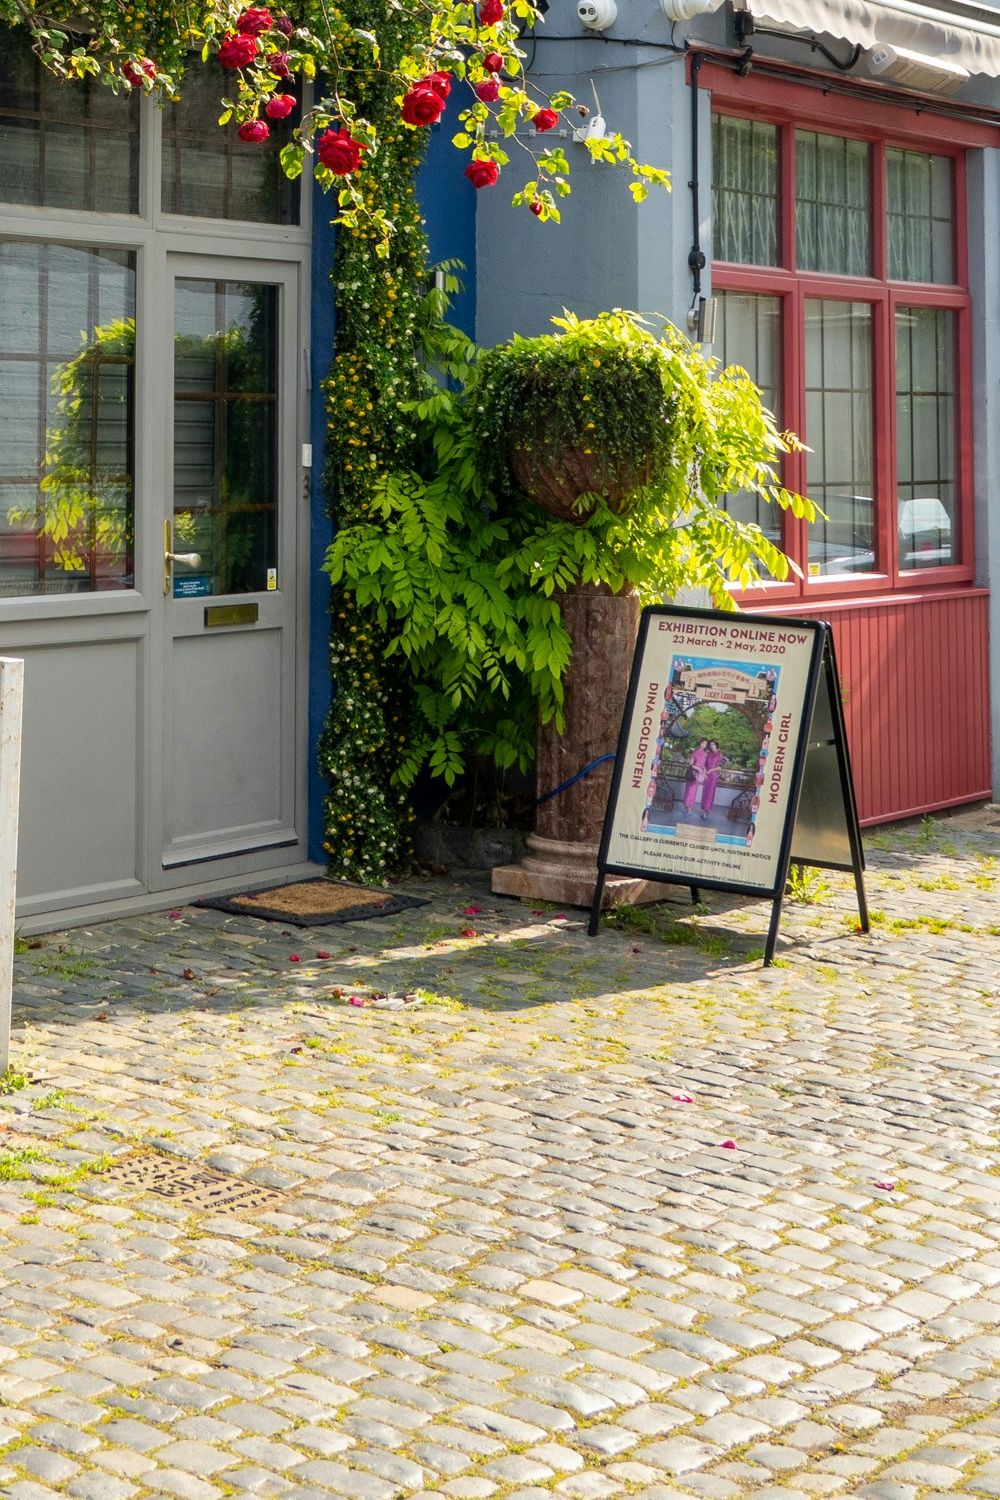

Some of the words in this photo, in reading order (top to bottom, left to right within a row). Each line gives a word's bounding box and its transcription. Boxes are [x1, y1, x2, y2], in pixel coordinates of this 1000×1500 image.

[658, 621, 727, 637] EXHIBITION
[730, 628, 775, 642] ONLINE
[778, 633, 807, 644] NOW
[672, 635, 684, 644] 23
[686, 636, 717, 647] March
[726, 640, 732, 649] 2
[734, 642, 757, 652] May,
[760, 644, 785, 654] 2020
[644, 682, 659, 713] DINA
[631, 716, 652, 789] GOLDSTEIN
[768, 746, 786, 804] MODERN
[778, 712, 792, 743] GIRL
[659, 839, 688, 847] CURRENTLY
[689, 843, 710, 851] CLOSED
[727, 849, 750, 857] FURTHER
[643, 850, 662, 858] PLEASE
[697, 858, 720, 866] ACTIVITY
[721, 862, 741, 870] ONLINE
